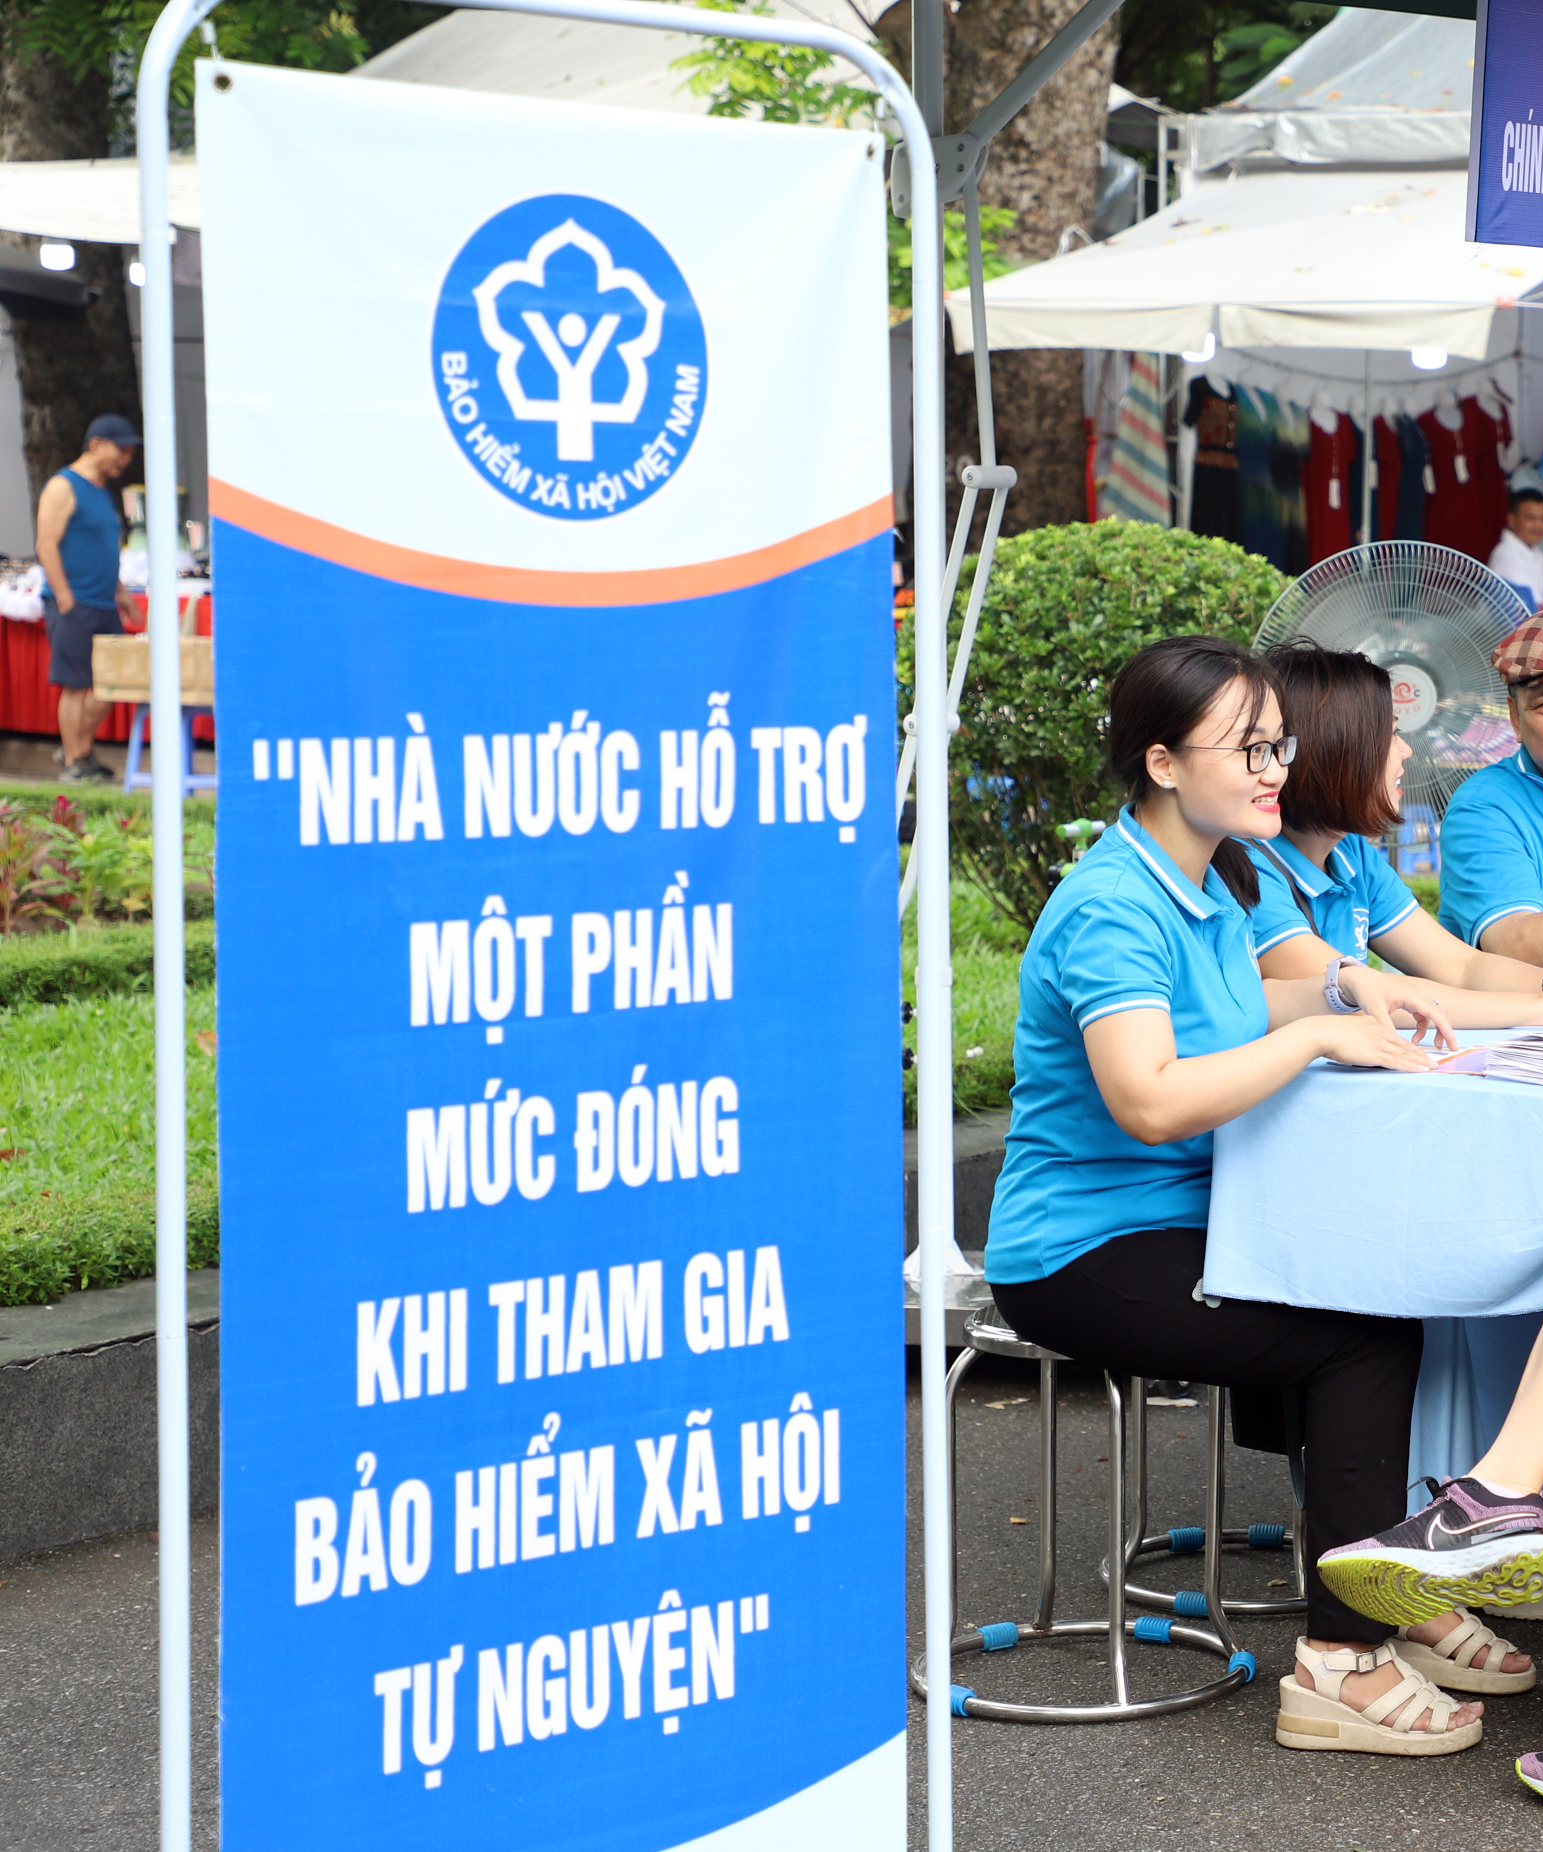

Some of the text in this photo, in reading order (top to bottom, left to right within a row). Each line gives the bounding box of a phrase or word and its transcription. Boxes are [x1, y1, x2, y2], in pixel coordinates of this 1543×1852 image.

[441, 351, 701, 513] BẢO HIỂM XÃ HỘI VIỆT NAM
[463, 709, 641, 839] NƯỚC
[659, 690, 736, 830] HỖ
[750, 715, 868, 843] TRỢ
[409, 869, 733, 1046] MỘT PHẦN
[406, 1064, 740, 1214] MỨC ĐÓNG
[356, 1244, 790, 1408] KHI THAM GIA
[294, 1392, 841, 1607] BẢO HIỂM XÃ HỘI
[373, 1644, 464, 1790] TỰ
